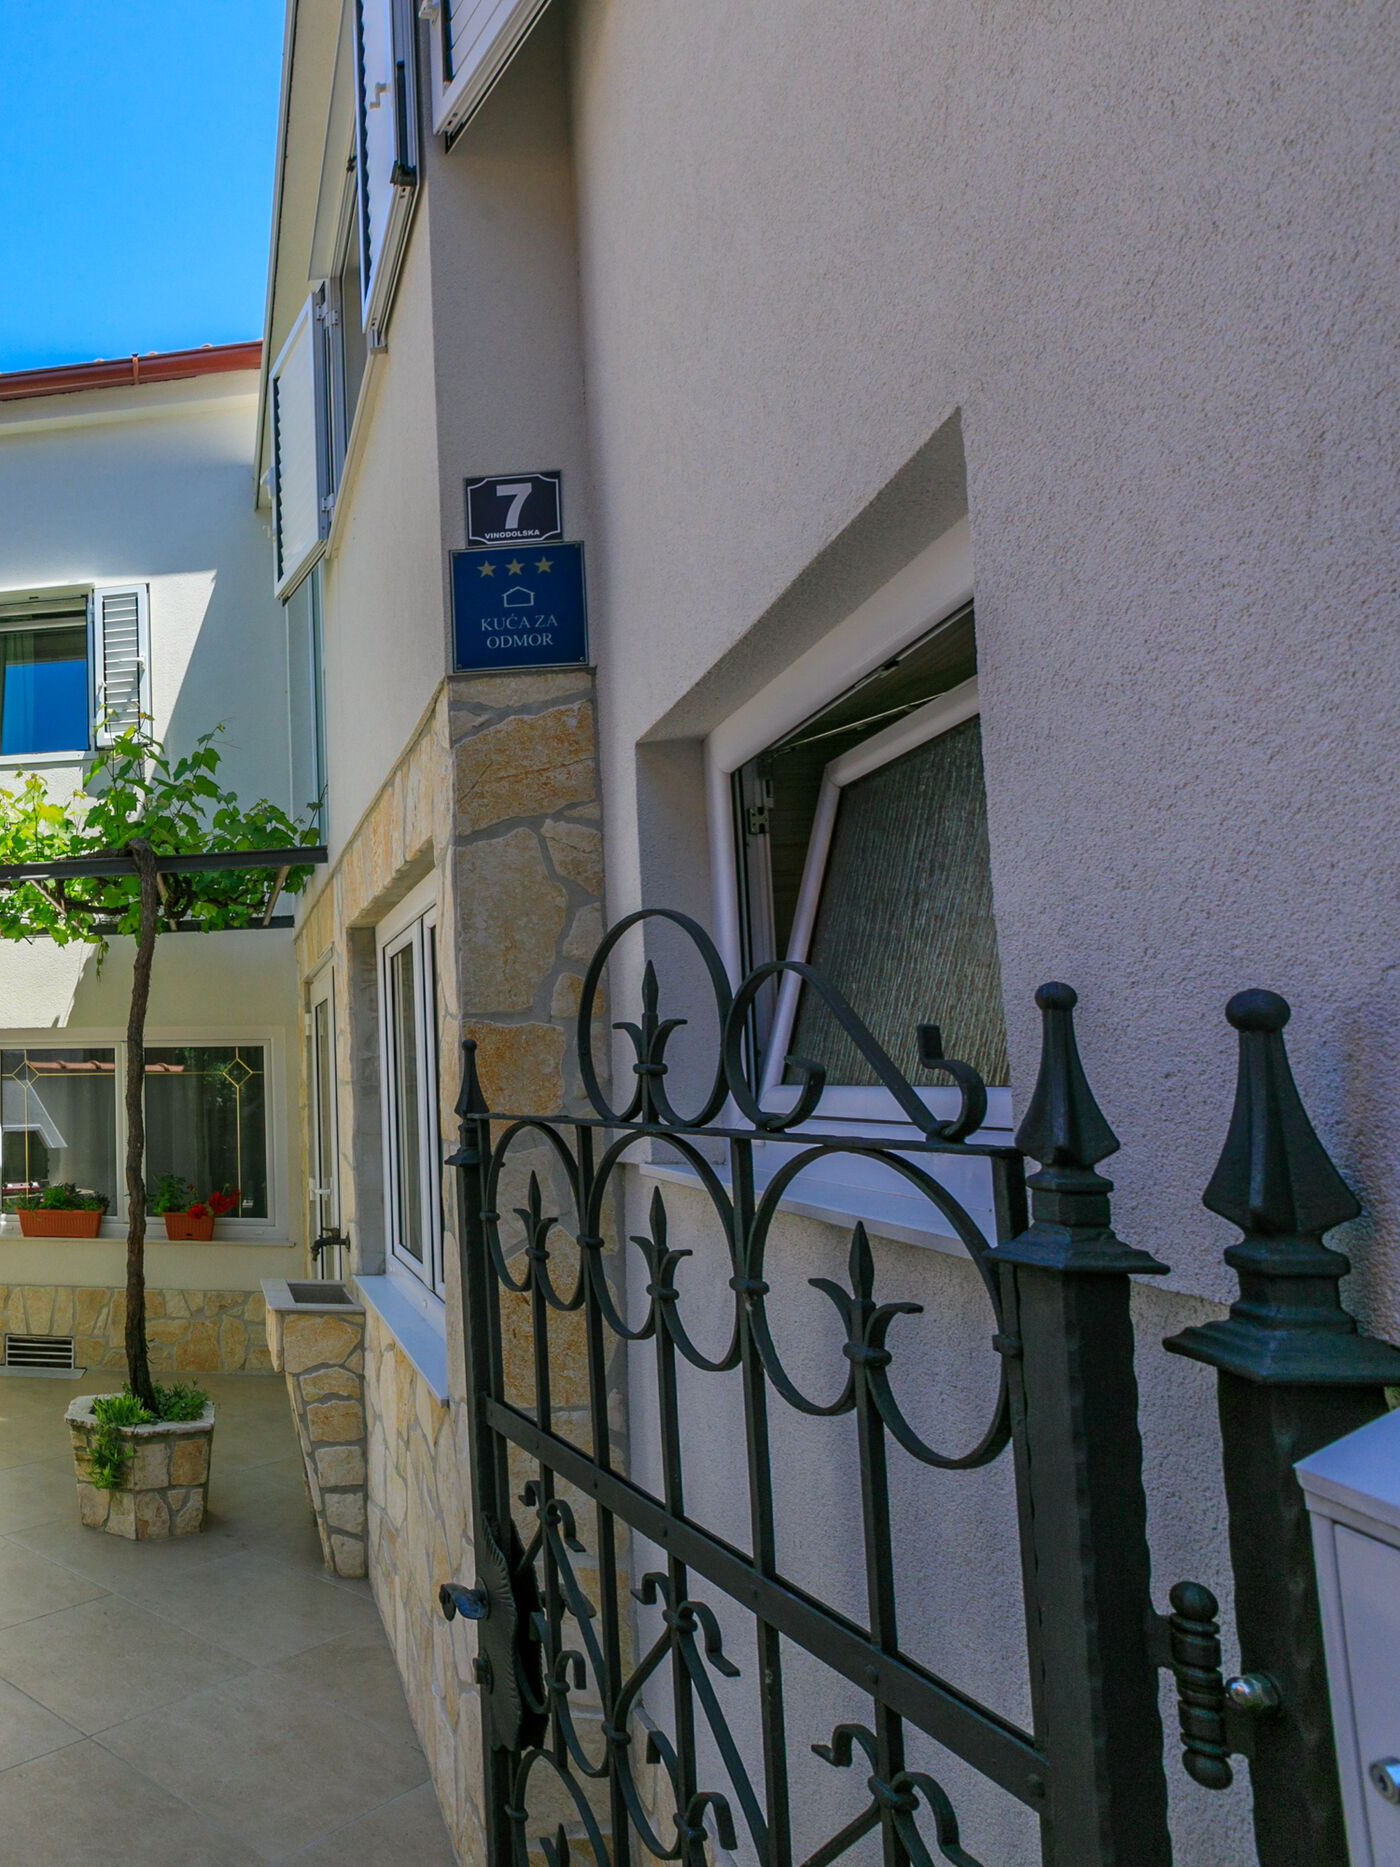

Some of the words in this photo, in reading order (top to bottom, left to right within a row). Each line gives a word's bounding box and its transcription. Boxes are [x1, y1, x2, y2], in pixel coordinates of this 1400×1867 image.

[496, 482, 532, 529] 7
[484, 528, 540, 540] VINODOLSKA
[481, 614, 531, 631] KUĆA
[535, 614, 558, 628] ZA
[486, 632, 554, 649] ODMOR
